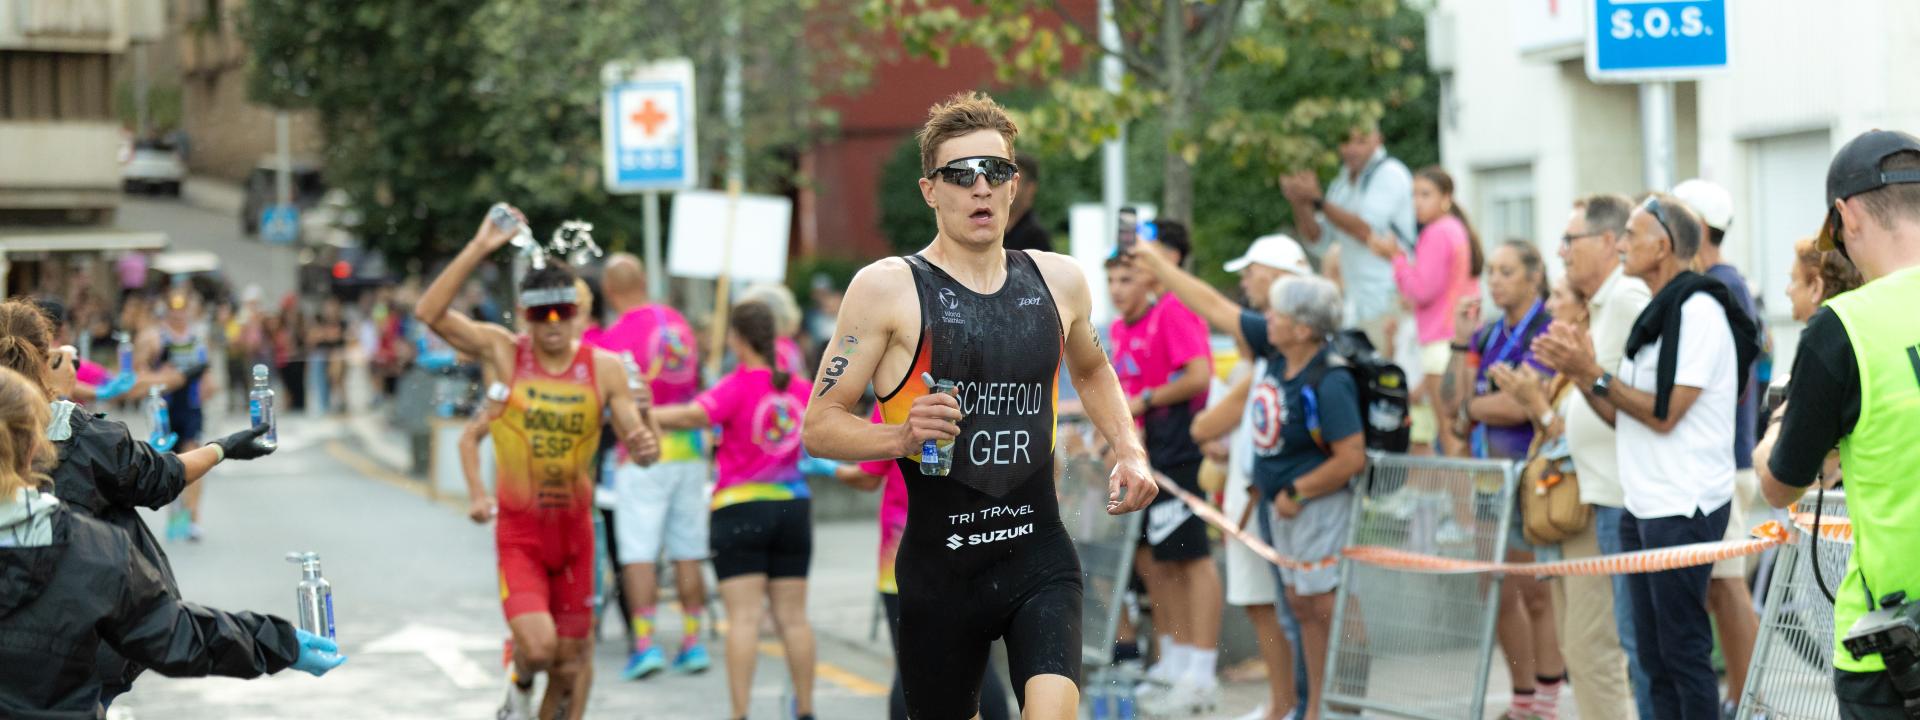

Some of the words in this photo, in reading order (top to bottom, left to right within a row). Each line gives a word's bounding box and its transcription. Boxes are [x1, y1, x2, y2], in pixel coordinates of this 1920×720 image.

[1610, 6, 1713, 40] S.O.S.
[942, 316, 966, 325] Triathlon
[944, 310, 961, 318] World
[957, 381, 1042, 416] SCHEFFOLD
[531, 434, 573, 458] ESP
[969, 430, 1031, 466] GER
[949, 512, 975, 525] TRI
[980, 504, 1034, 520] TRAVEL
[968, 523, 1034, 546] SUZUKI
